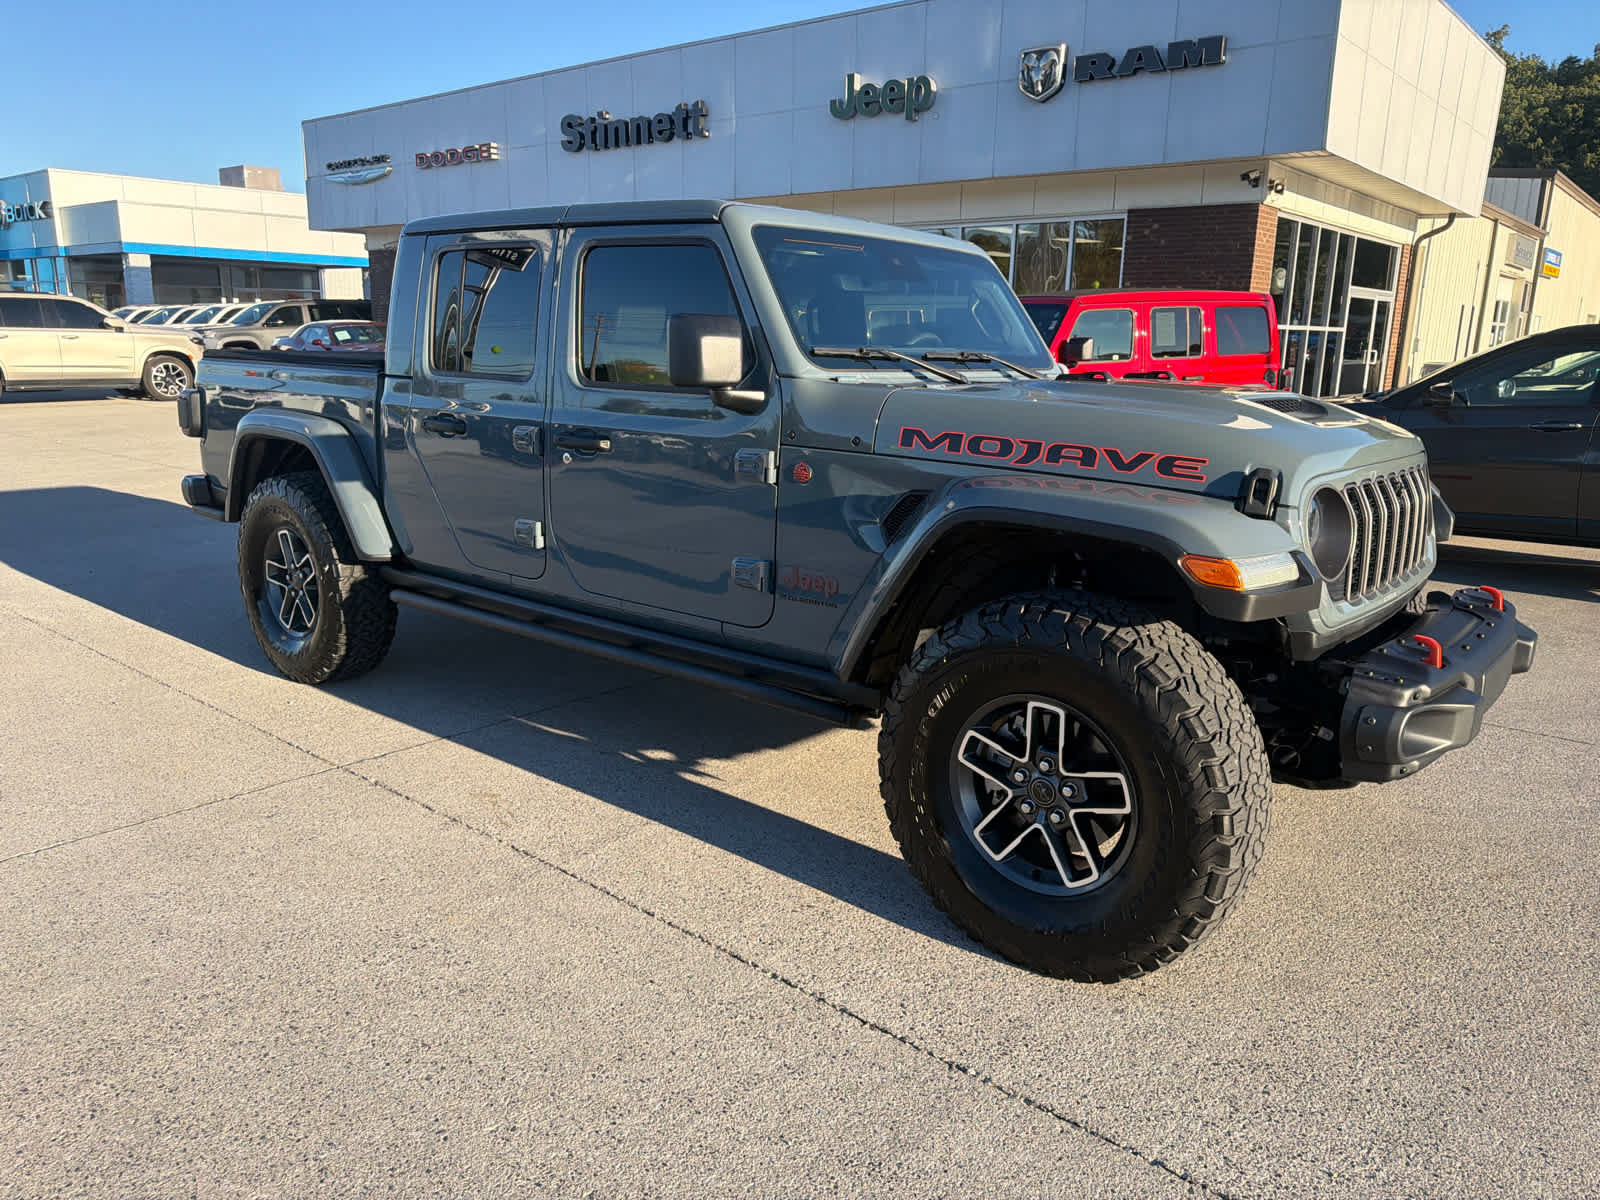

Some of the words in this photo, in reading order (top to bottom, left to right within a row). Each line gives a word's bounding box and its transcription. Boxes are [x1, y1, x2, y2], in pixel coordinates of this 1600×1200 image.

[1073, 35, 1226, 82] RAM
[829, 72, 937, 122] Jeep
[560, 99, 711, 153] Stinnett
[415, 142, 499, 169] DODGE
[6, 201, 48, 223] BUICK
[898, 426, 1209, 482] MOJAVE
[783, 567, 840, 598] Jeep
